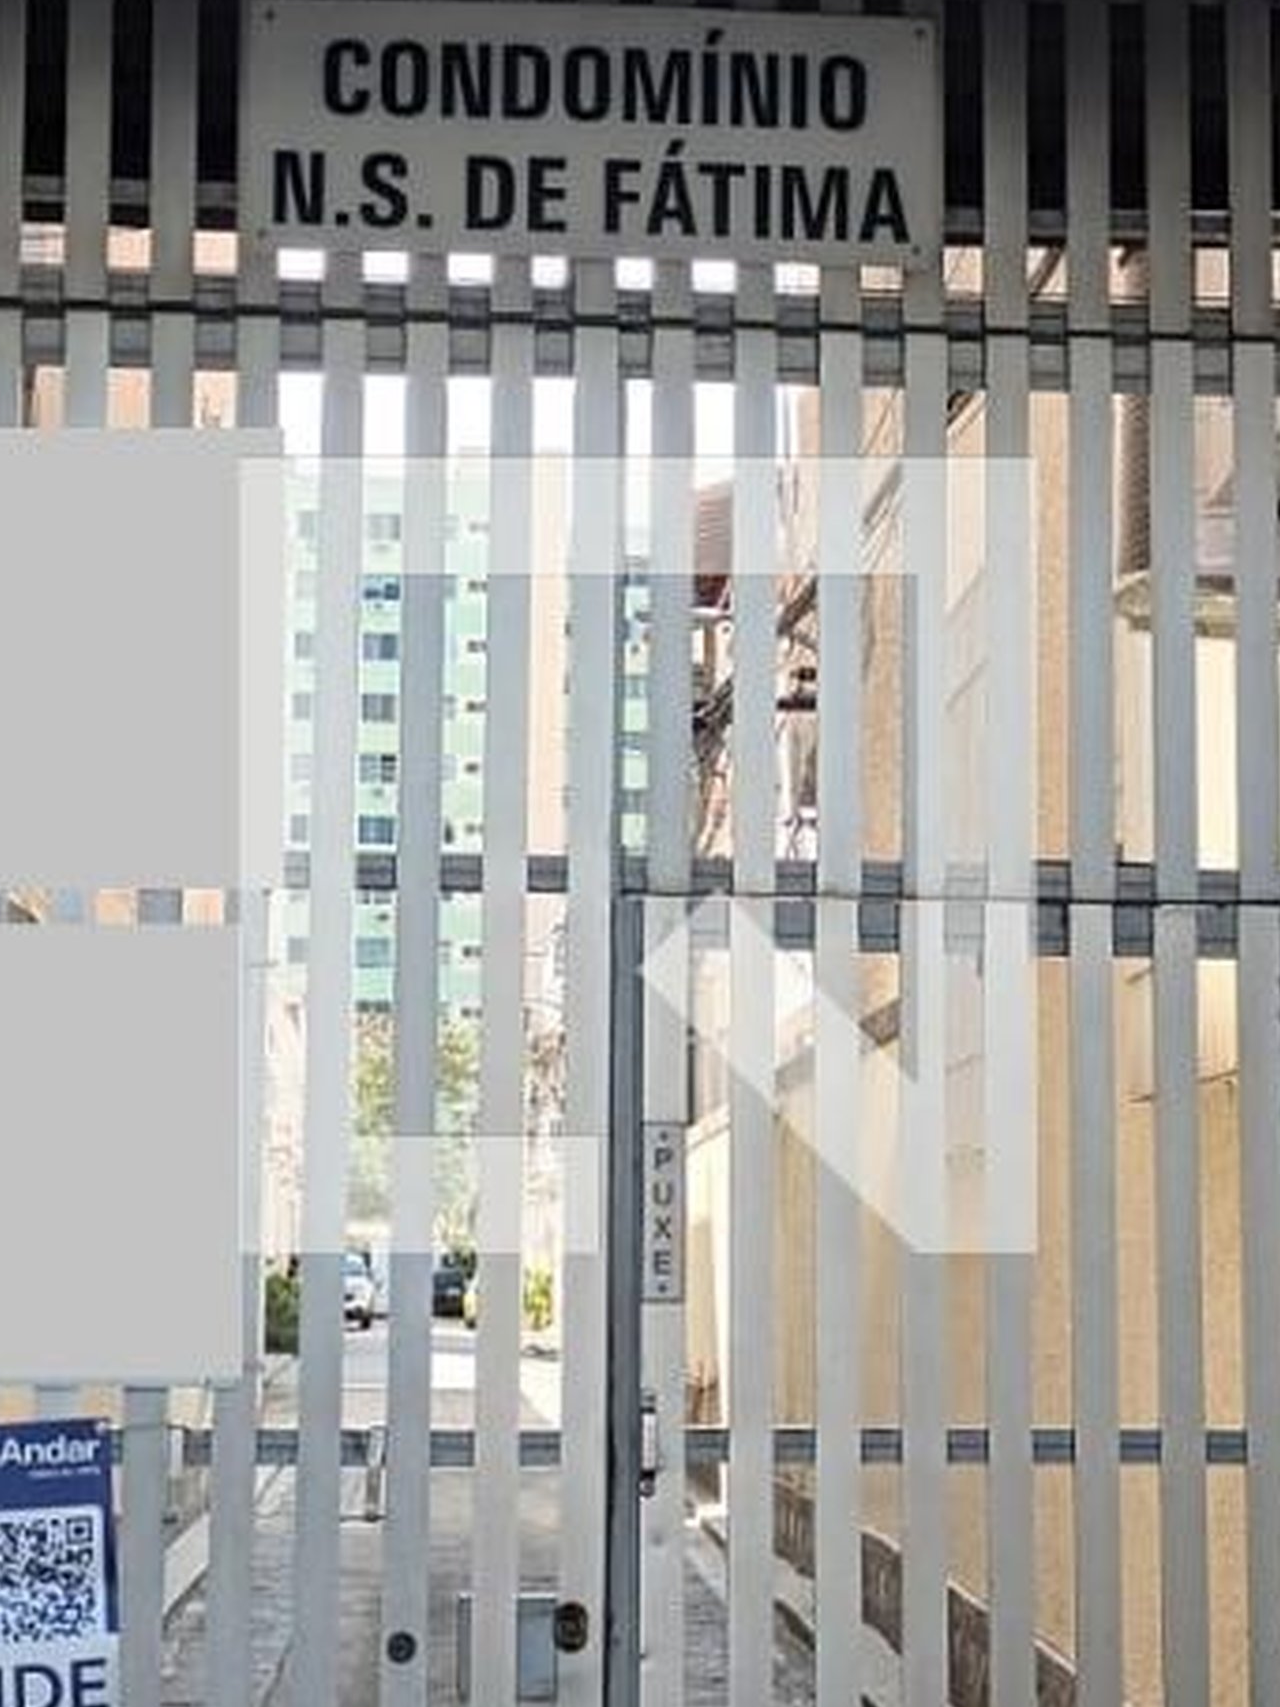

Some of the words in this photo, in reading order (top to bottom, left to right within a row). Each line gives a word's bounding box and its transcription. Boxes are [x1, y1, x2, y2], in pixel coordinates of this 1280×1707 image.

[322, 30, 868, 131] CONDOMÍNIO
[272, 149, 432, 230] N.S.
[465, 155, 567, 232] DE
[604, 140, 910, 244] FÁTIMA
[652, 1147, 675, 1276] PUXE
